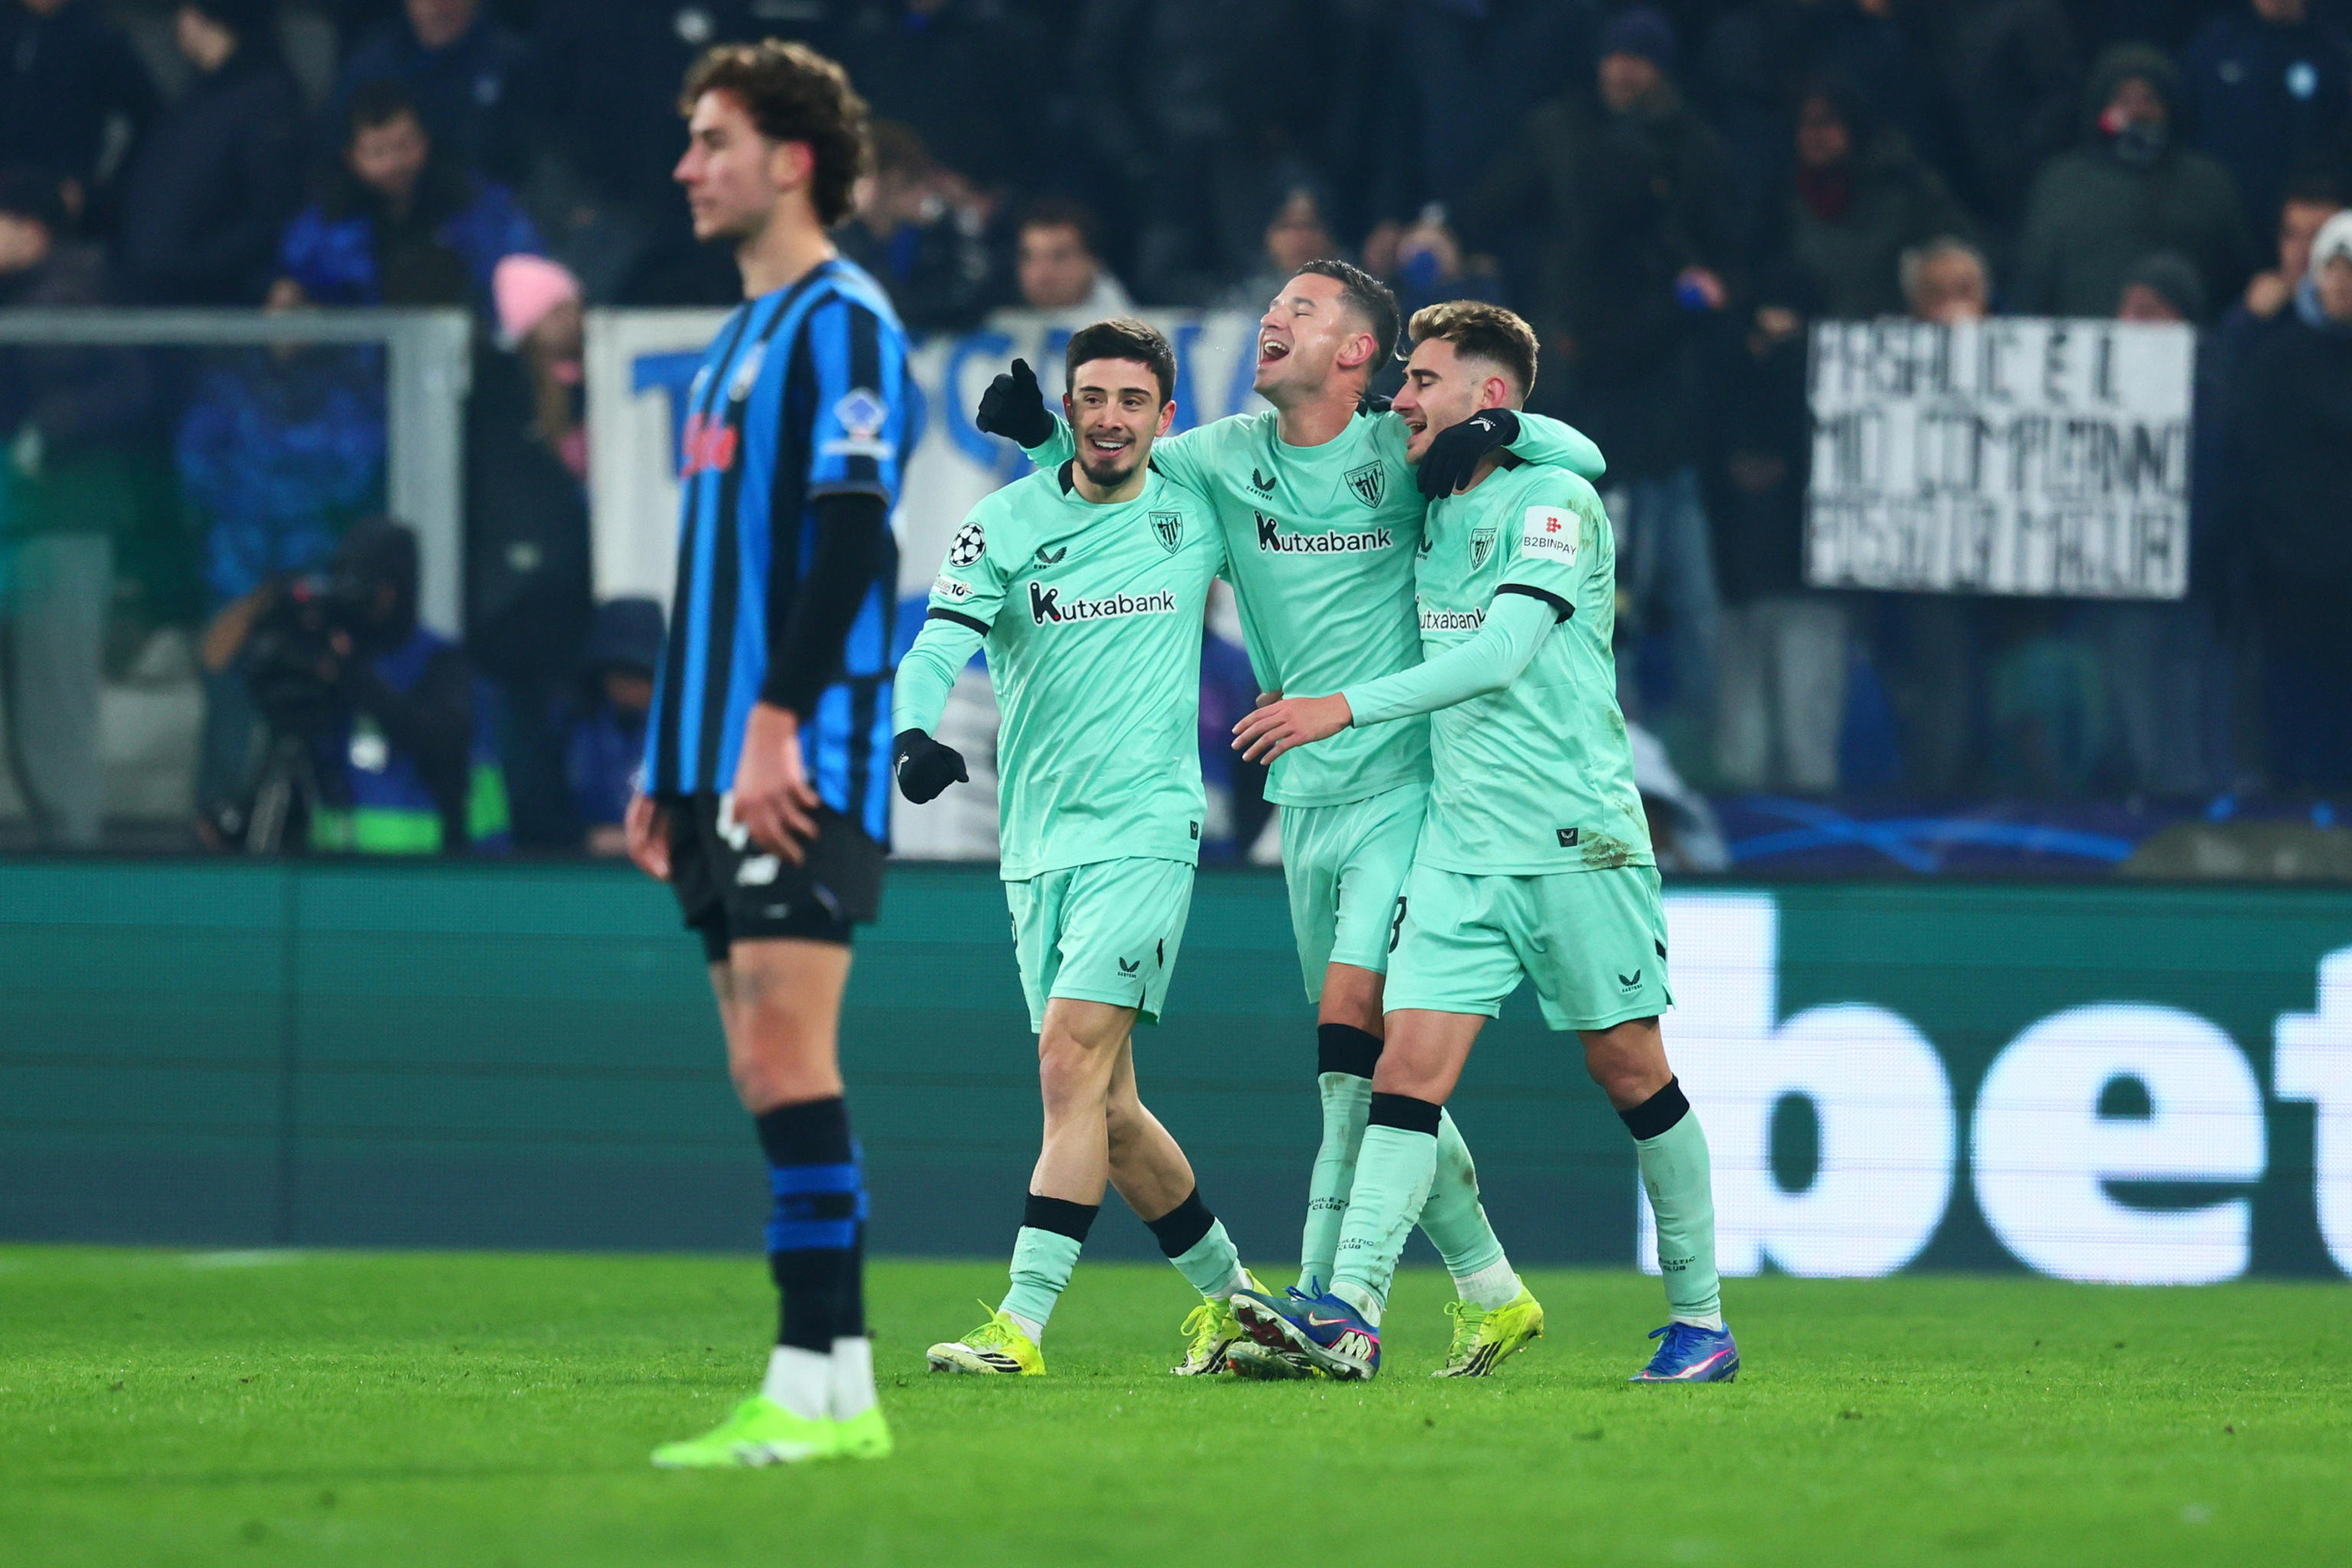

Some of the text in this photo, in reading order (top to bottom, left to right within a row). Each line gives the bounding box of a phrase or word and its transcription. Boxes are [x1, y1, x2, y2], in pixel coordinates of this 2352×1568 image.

[1254, 510, 1392, 552] Kutxabank
[1523, 536, 1577, 555] B2BINPAY
[1029, 582, 1174, 625] Kutxabank
[1416, 601, 1486, 629] utxabank
